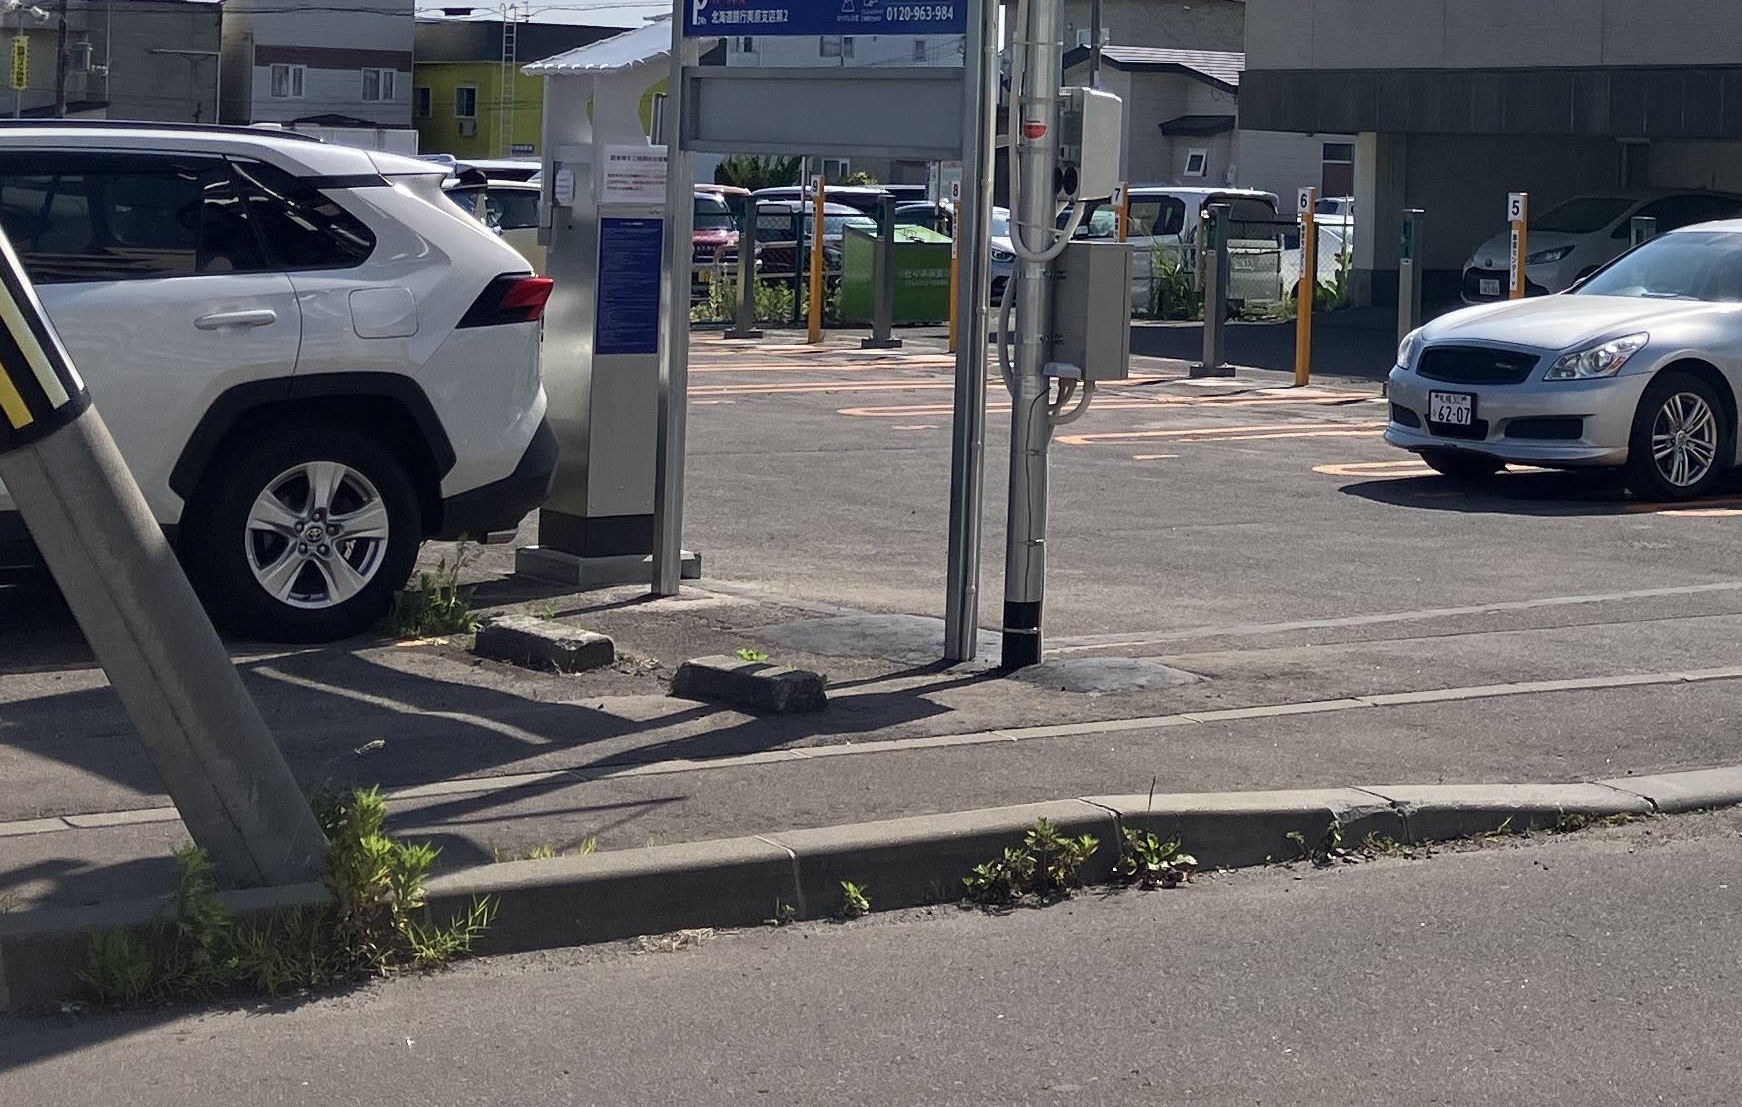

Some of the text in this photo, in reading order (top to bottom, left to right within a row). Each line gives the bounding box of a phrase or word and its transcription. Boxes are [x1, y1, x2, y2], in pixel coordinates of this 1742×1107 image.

[887, 5, 954, 21] 0120-963-984
[812, 179, 819, 192] 9
[952, 183, 959, 197] 8
[1114, 187, 1121, 202] 7
[1300, 193, 1308, 208] 6
[1511, 199, 1520, 216] 5
